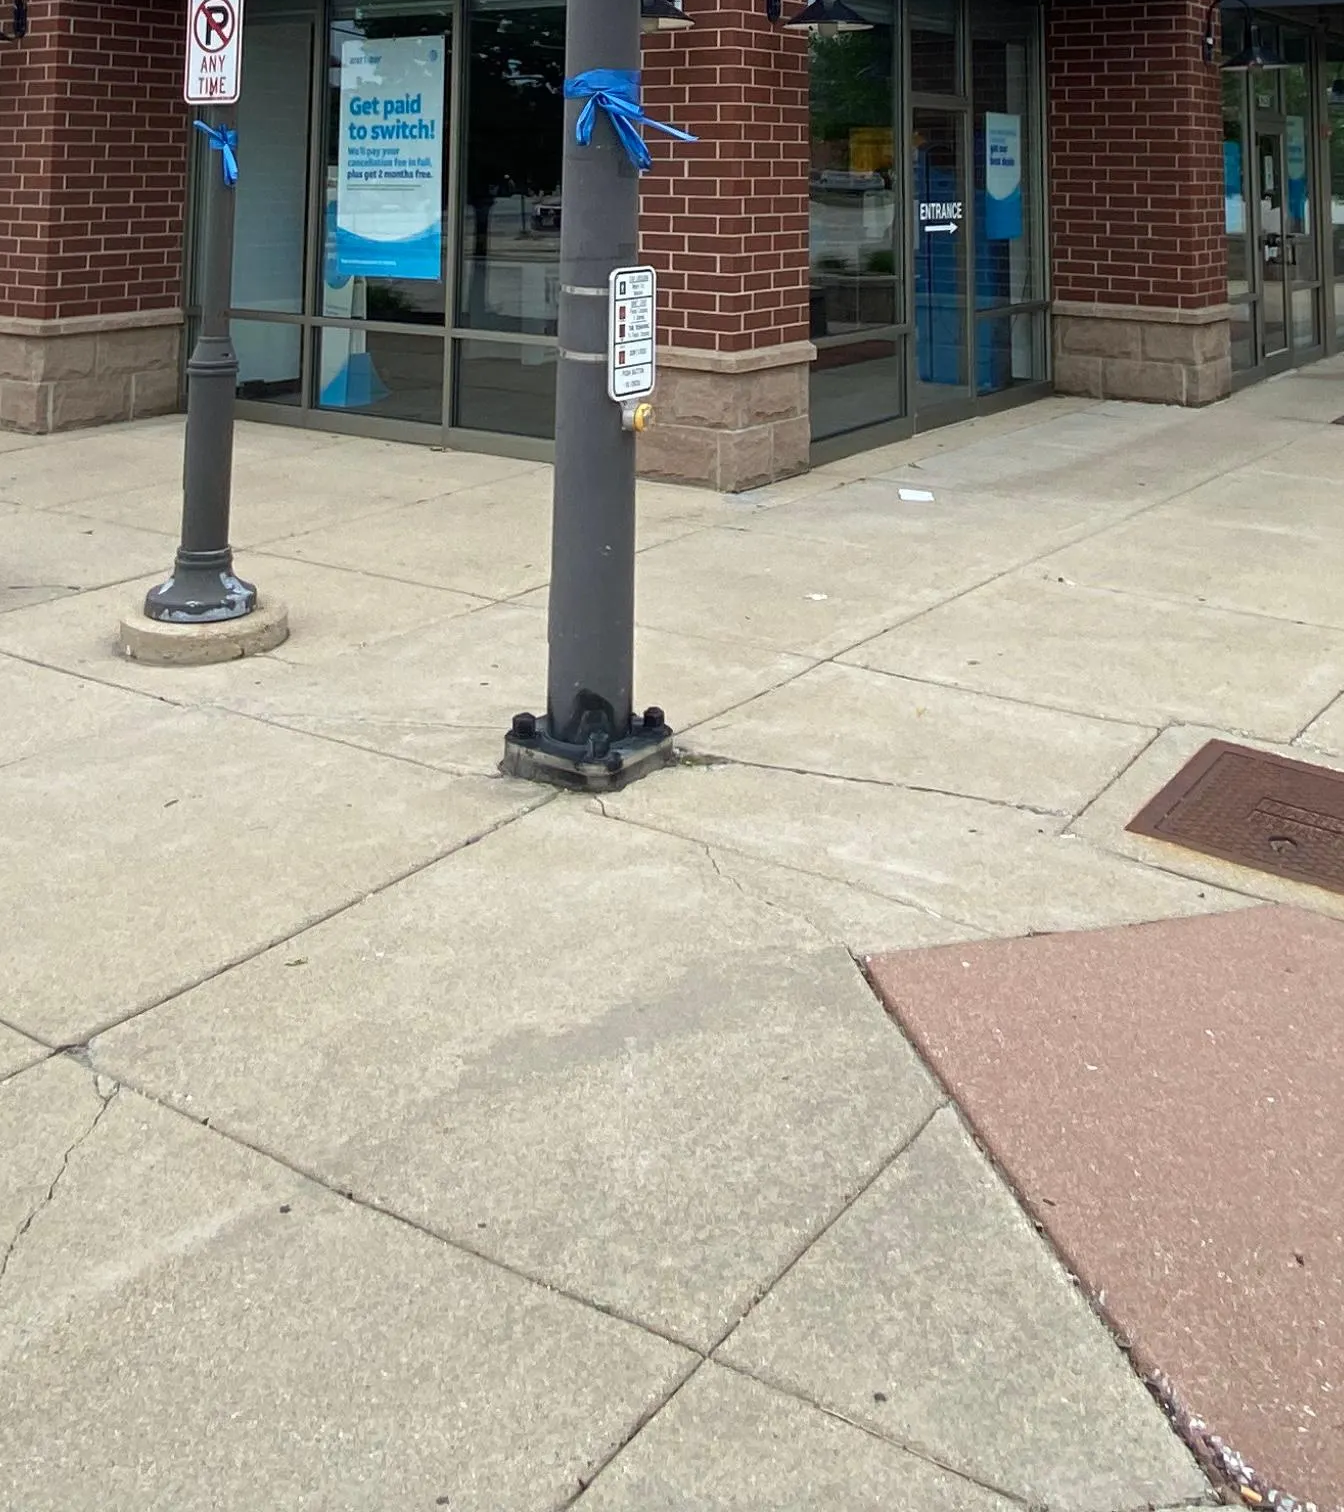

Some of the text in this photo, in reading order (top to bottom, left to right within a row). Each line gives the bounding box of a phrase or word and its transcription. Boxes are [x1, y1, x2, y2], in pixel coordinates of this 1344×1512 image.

[200, 54, 227, 74] ANY
[198, 76, 227, 95] TIME
[349, 92, 422, 120] Get paid
[348, 118, 436, 140] to switch!
[366, 148, 381, 158] pay
[382, 148, 400, 158] your
[347, 169, 363, 180] plus
[364, 170, 377, 181] get
[384, 169, 414, 179] months
[920, 202, 962, 220] ENTRANCE
